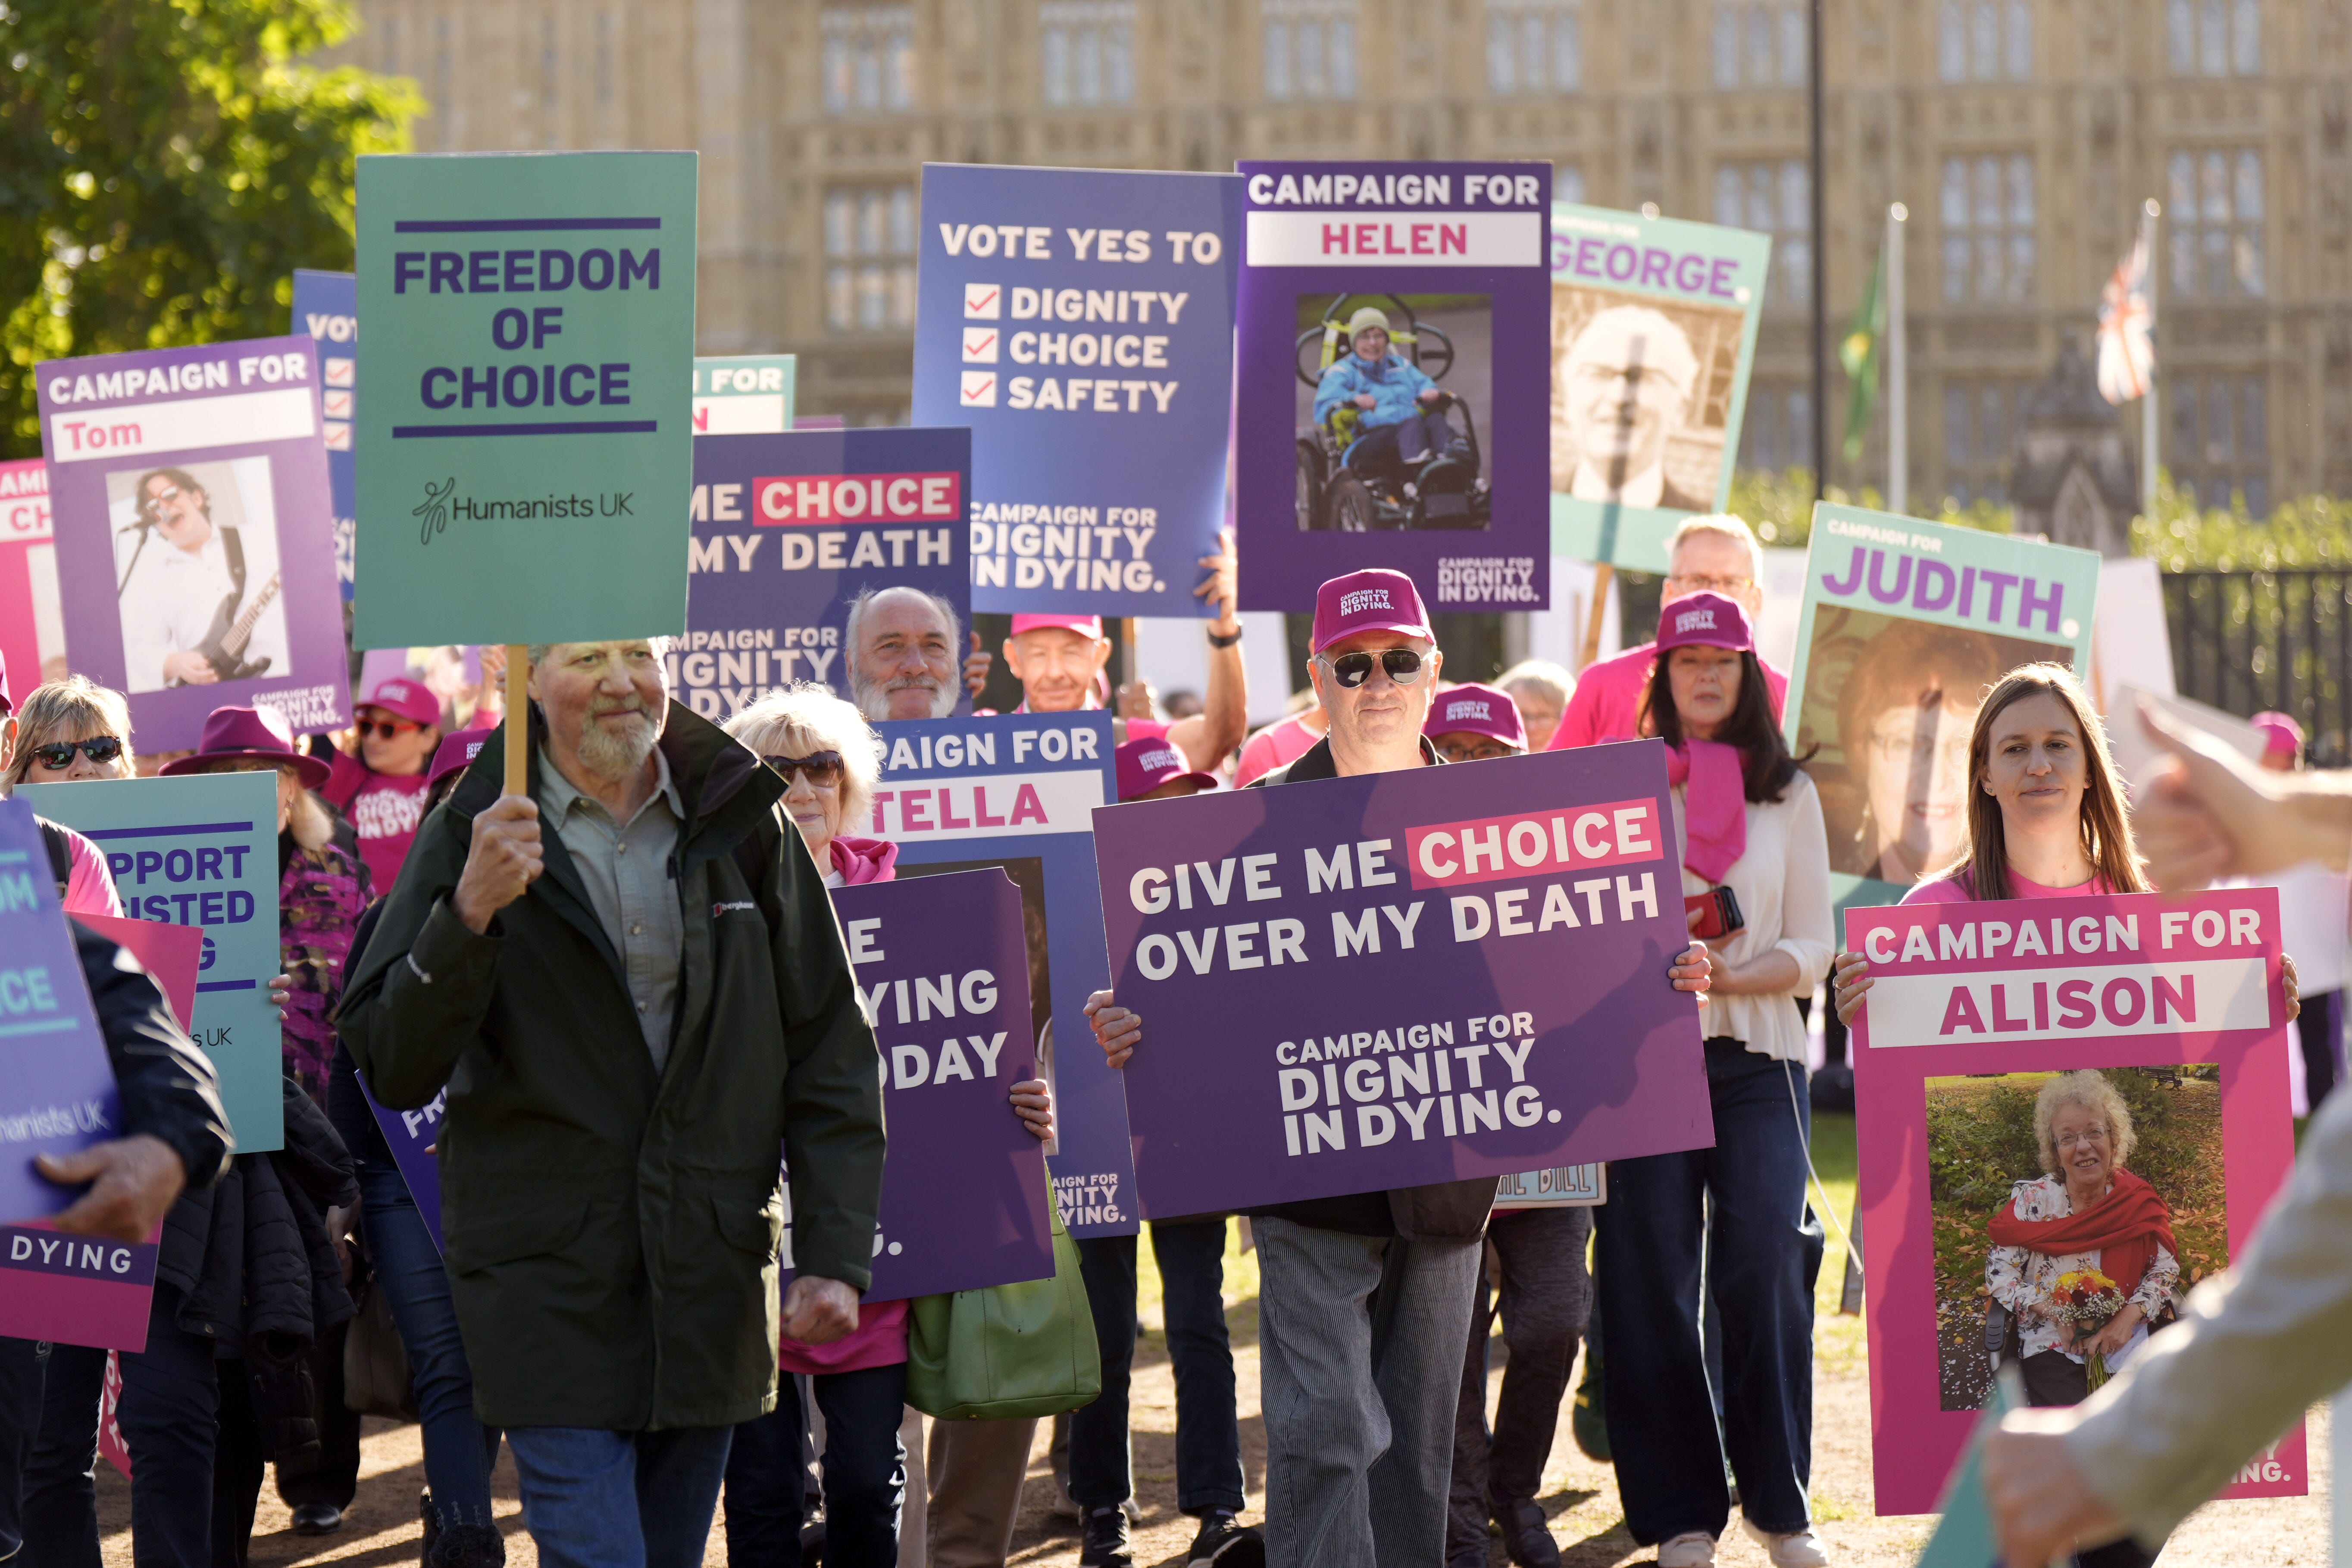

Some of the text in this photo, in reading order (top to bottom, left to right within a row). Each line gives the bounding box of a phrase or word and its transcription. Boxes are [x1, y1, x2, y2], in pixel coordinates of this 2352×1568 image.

[1248, 174, 1540, 205] CAMPAIGN FOR
[939, 223, 1221, 265] VOTE YES TO
[1322, 223, 1467, 255] HELEN
[394, 248, 660, 294] FREEDOM
[1011, 287, 1189, 324] DIGNITY
[492, 307, 563, 350] OF
[1009, 331, 1169, 368] CHOICE
[49, 353, 307, 405] CAMPAIGN FOR
[420, 363, 631, 410] CHOICE
[712, 367, 784, 393] FOR
[1007, 376, 1178, 413] SAFETY
[63, 422, 142, 451] Tom
[453, 492, 633, 520] Humanists UK
[761, 478, 951, 520] CHOICE
[970, 501, 1157, 528] CAMPAIGN FOR
[688, 529, 950, 574] MY DEATH
[970, 522, 1156, 560] DIGNITY
[1827, 520, 1943, 553] CAMPAIGN FOR
[1015, 557, 1166, 593] DYING.
[1438, 567, 1534, 585] DIGNITY
[1438, 584, 1540, 602] IN DYING.
[1340, 589, 1373, 601] CAMPAIGN
[1341, 595, 1389, 609] DIGNITY
[1341, 601, 1394, 617] IN DYING.
[670, 627, 839, 652] MPAIGN FOR
[667, 648, 838, 688] IGNITY
[252, 689, 310, 704] CAMPAIGN
[1012, 727, 1099, 764] FOR
[873, 783, 1049, 834] TELLA
[107, 845, 250, 885] PPORT
[1129, 806, 1652, 914] GIVE ME CHOICE
[120, 890, 255, 926] ISTED
[1136, 872, 1659, 981] OVER MY DEATH
[1865, 908, 2262, 965] CAMPAIGN FOR
[857, 970, 998, 1027] YING
[1939, 974, 2196, 1036] ALISON
[206, 1027, 233, 1046] UK
[1276, 1011, 1536, 1066] CAMPAIGN FOR
[1278, 1038, 1536, 1112] DIGNITY
[1283, 1085, 1562, 1157] IN DYING.
[1052, 1173, 1118, 1189] AIGN FOR
[1055, 1185, 1118, 1208] NITY
[1058, 1205, 1126, 1227] YING.
[10, 1235, 131, 1274] DYING
[2231, 1462, 2291, 1483] ING.
